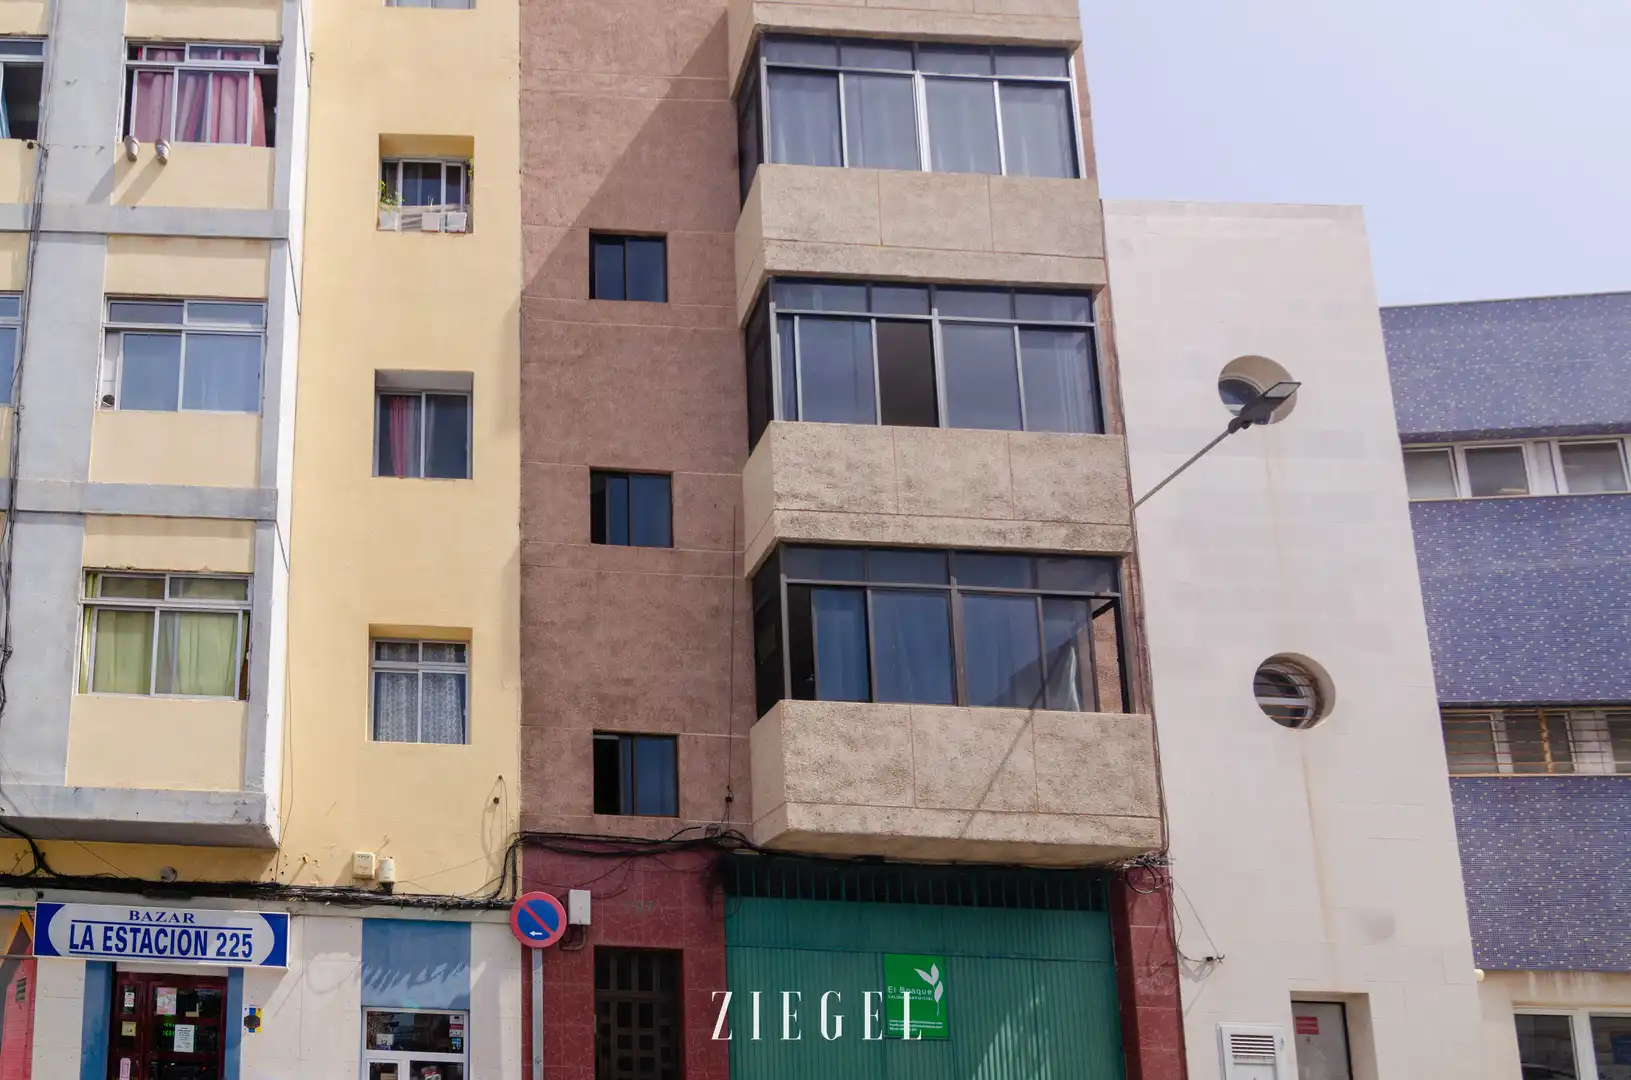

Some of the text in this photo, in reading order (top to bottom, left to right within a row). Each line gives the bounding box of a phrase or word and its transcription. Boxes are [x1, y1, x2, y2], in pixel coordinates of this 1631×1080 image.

[128, 910, 196, 924] BAZAR
[69, 923, 253, 958] LA ESTACION 225
[888, 986, 932, 995] El Bosque
